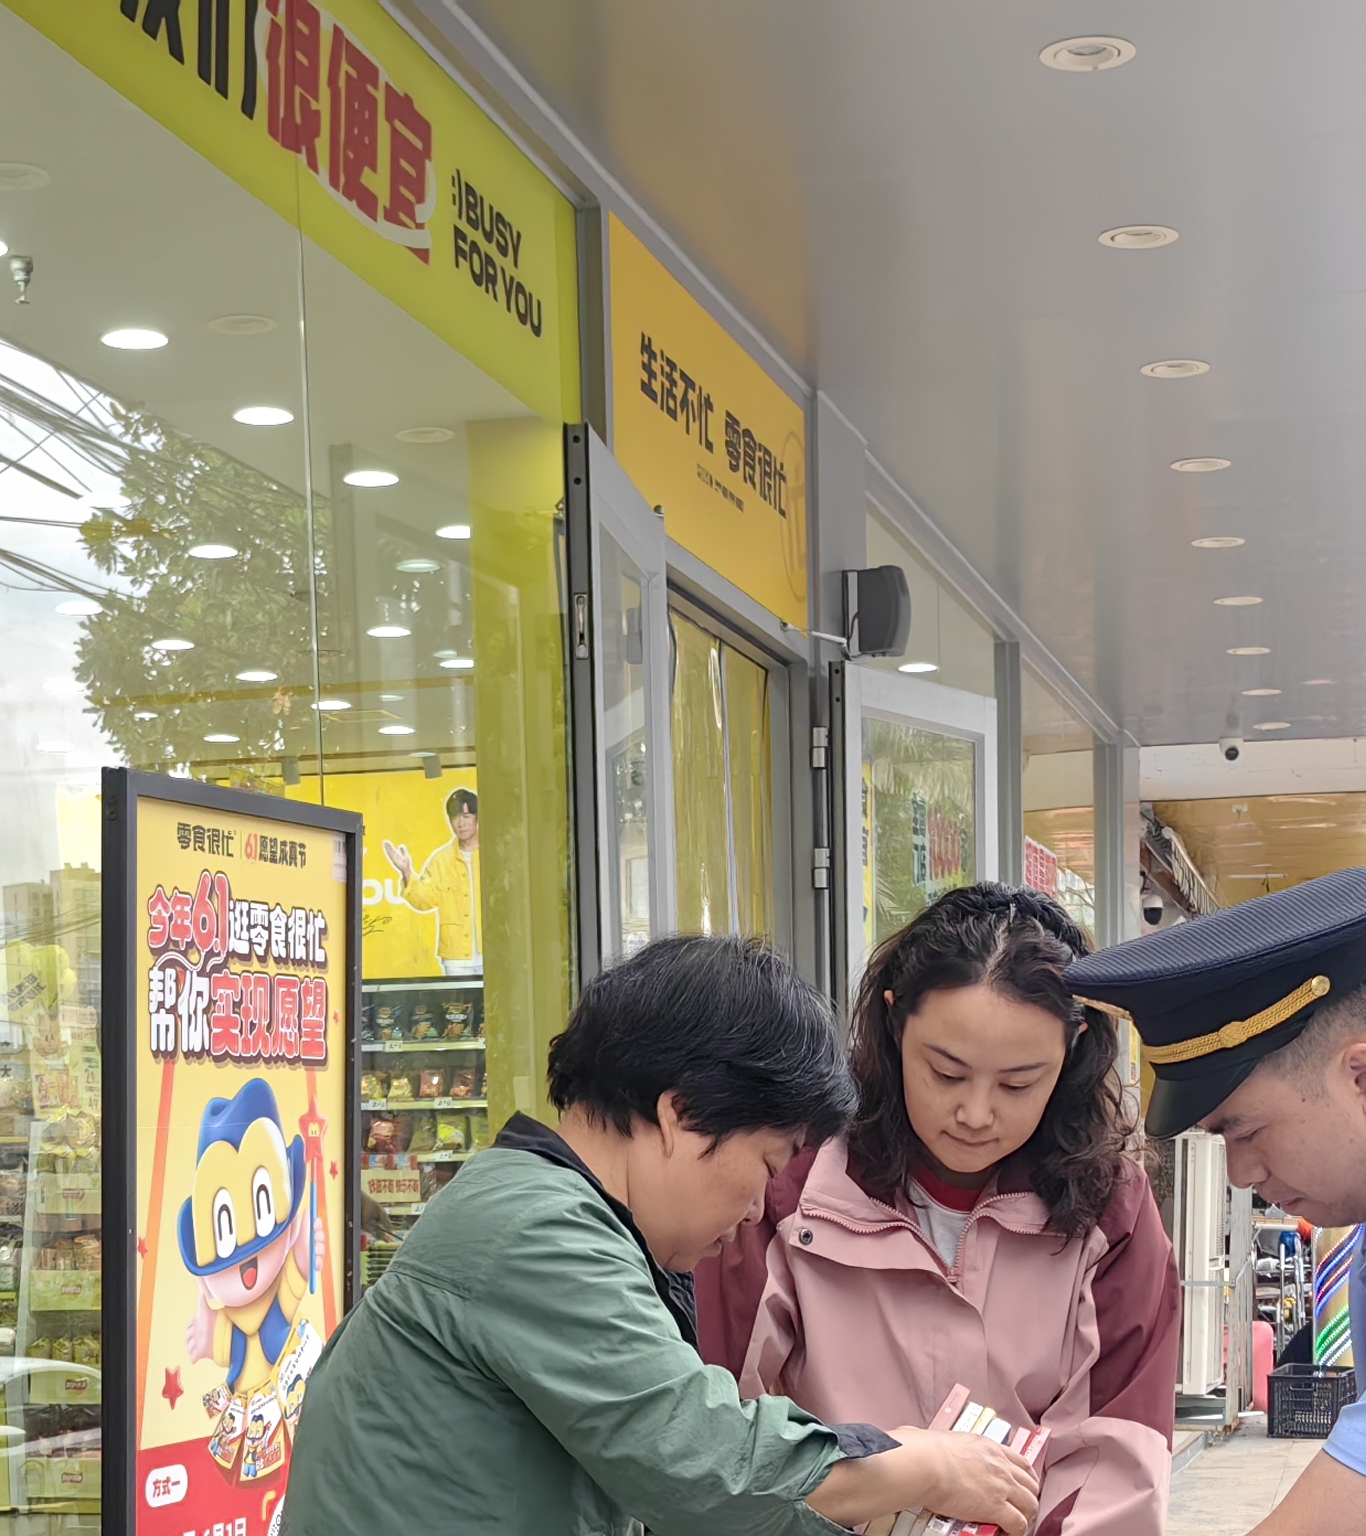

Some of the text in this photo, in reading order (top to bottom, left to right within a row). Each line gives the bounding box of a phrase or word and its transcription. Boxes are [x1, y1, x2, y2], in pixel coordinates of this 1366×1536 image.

[453, 223, 543, 338] FOR YOU
[640, 330, 715, 455] 生活不忙
[724, 408, 787, 520] 零食很忙
[176, 821, 235, 858] 零食很忙
[148, 967, 328, 1062] 帮你实现愿望
[152, 1476, 181, 1498] 方式一
